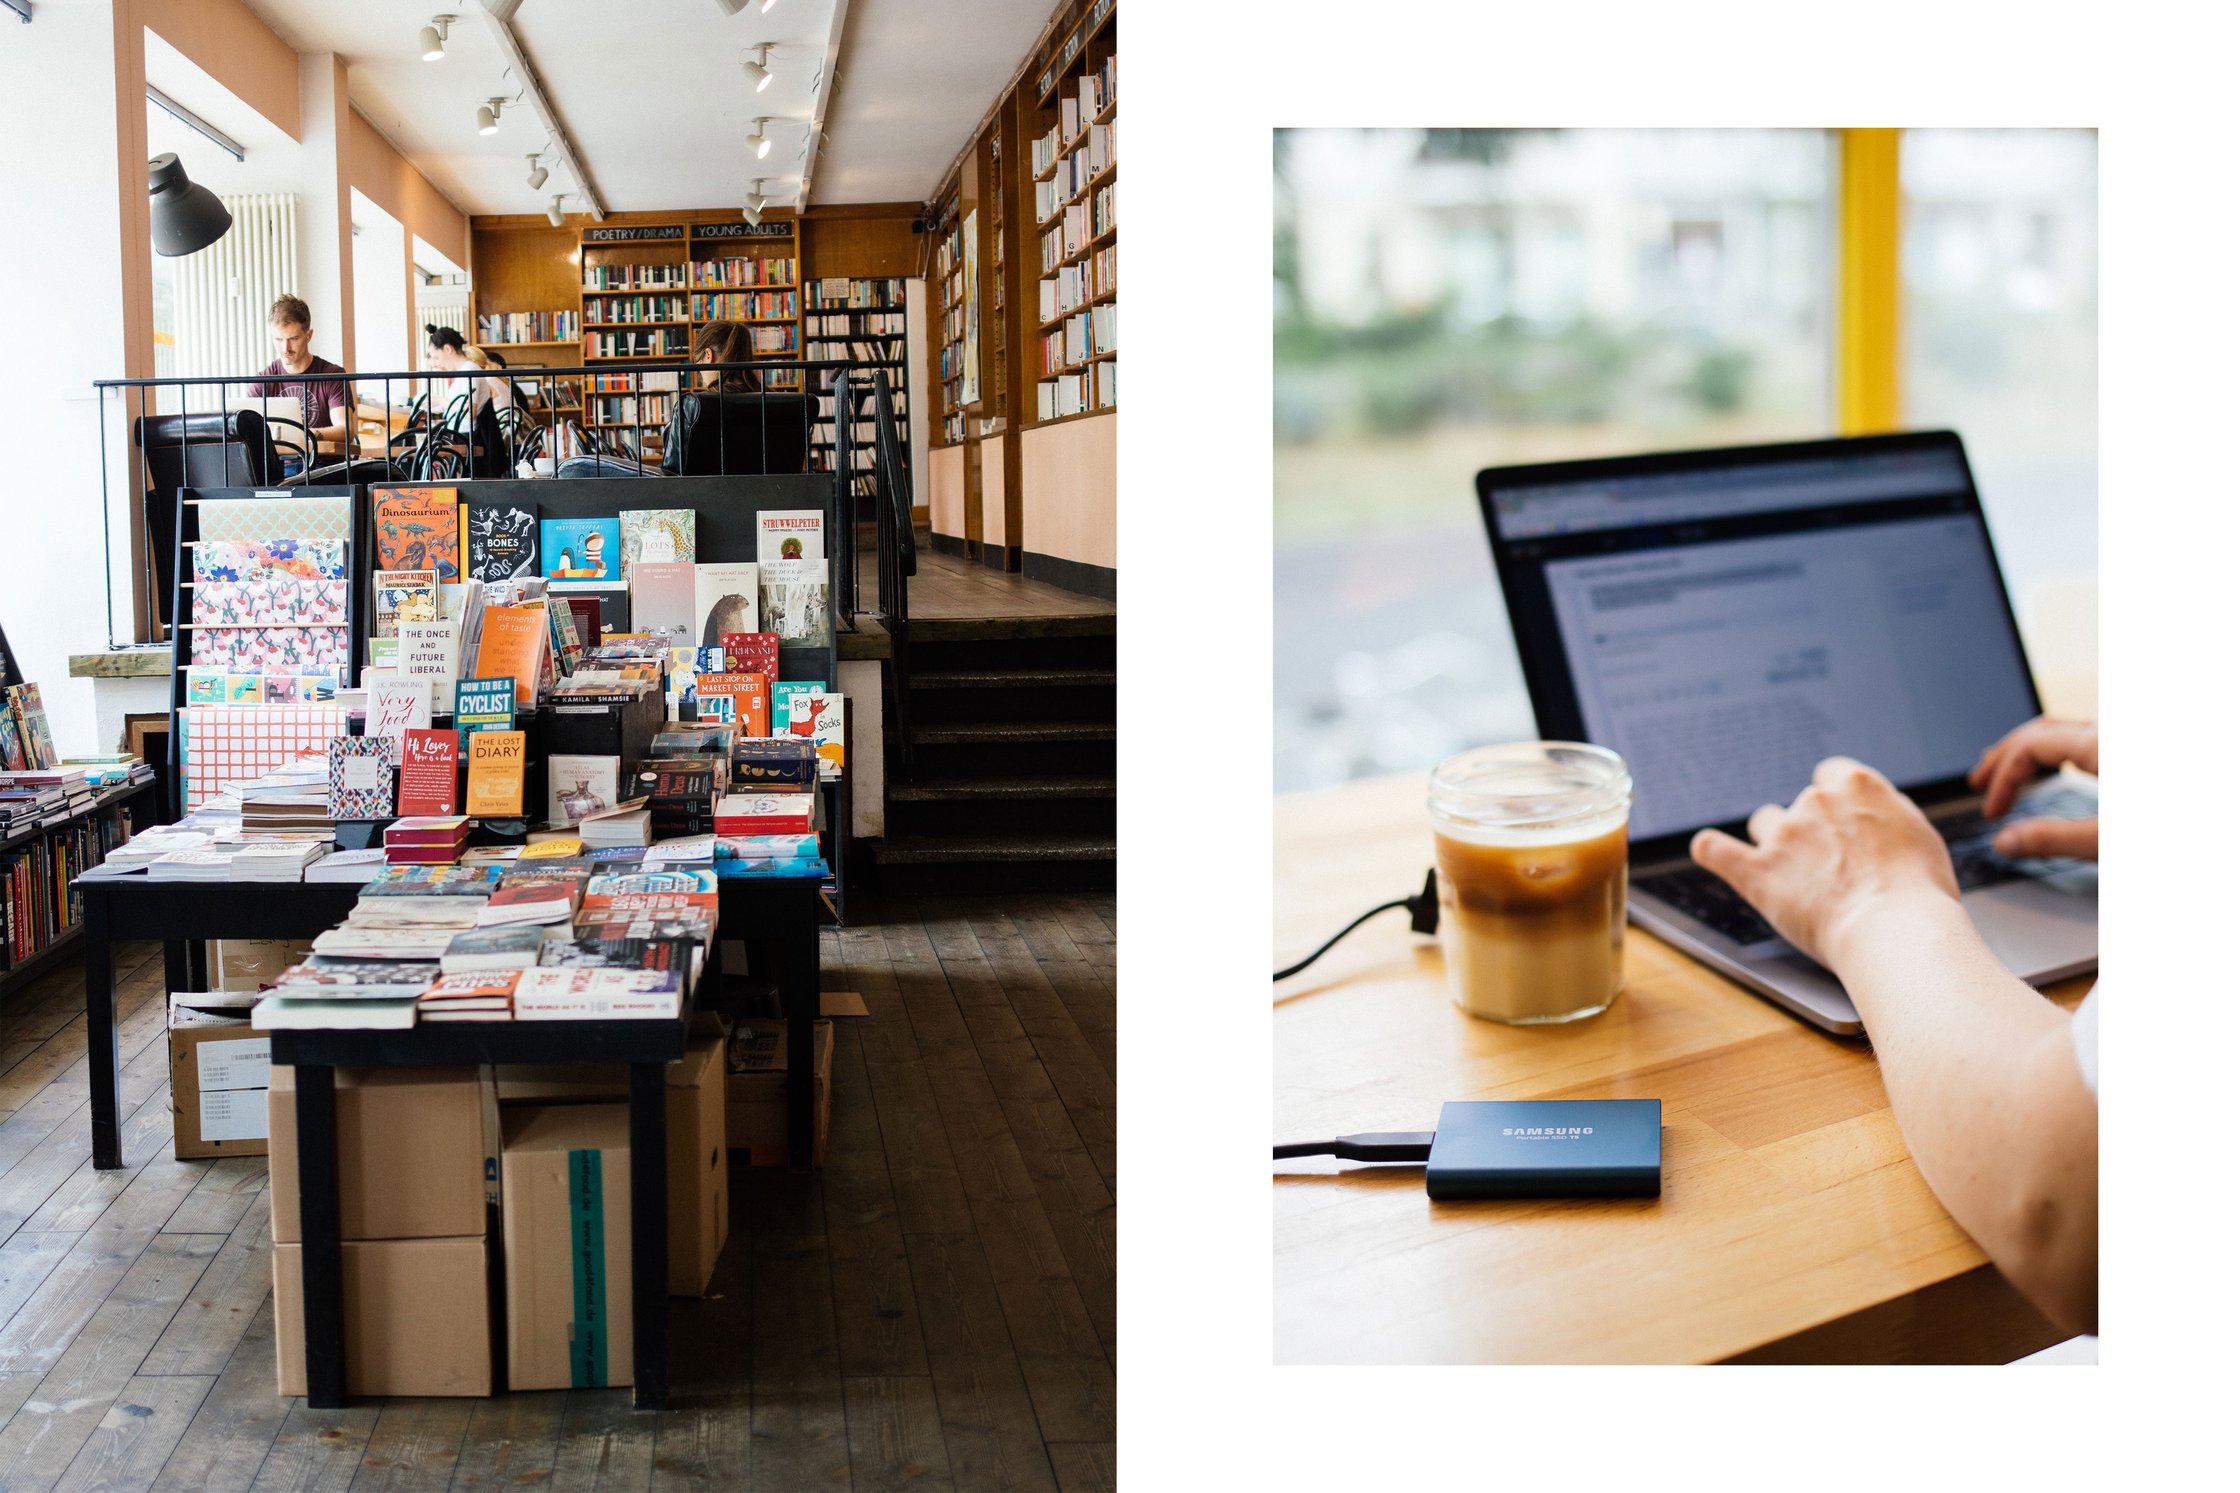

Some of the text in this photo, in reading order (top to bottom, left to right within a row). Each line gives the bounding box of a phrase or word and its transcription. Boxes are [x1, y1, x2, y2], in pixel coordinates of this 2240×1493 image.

[592, 227, 683, 240] POETRY/DRAMA
[699, 224, 788, 237] YOUNG ADULTS
[381, 508, 450, 517] Dinosaurium
[762, 518, 820, 528] STRUWWELPETER
[487, 538, 519, 548] BONES
[410, 572, 434, 584] KITCHEN
[496, 612, 536, 624] elements
[406, 630, 451, 638] THE ONCE
[512, 624, 532, 632] taste
[410, 654, 445, 662] FUTURE
[410, 666, 446, 674] LIBERAL
[461, 680, 510, 692] HOW TO BE A
[702, 684, 760, 692] MARKET STREET
[378, 690, 416, 712] Very
[460, 692, 512, 714] CYCLIST
[794, 700, 809, 712] Fox
[818, 718, 841, 732] Socks
[408, 736, 451, 756] Hi Lover
[498, 738, 521, 746] LOST
[414, 753, 428, 762] Here
[440, 753, 452, 762] book
[476, 746, 520, 758] DIARY
[654, 773, 670, 796] Homo
[670, 776, 686, 794] Deus
[1502, 1127, 1594, 1136] SAMSUNG
[582, 1220, 597, 1323] www.good4food.de
